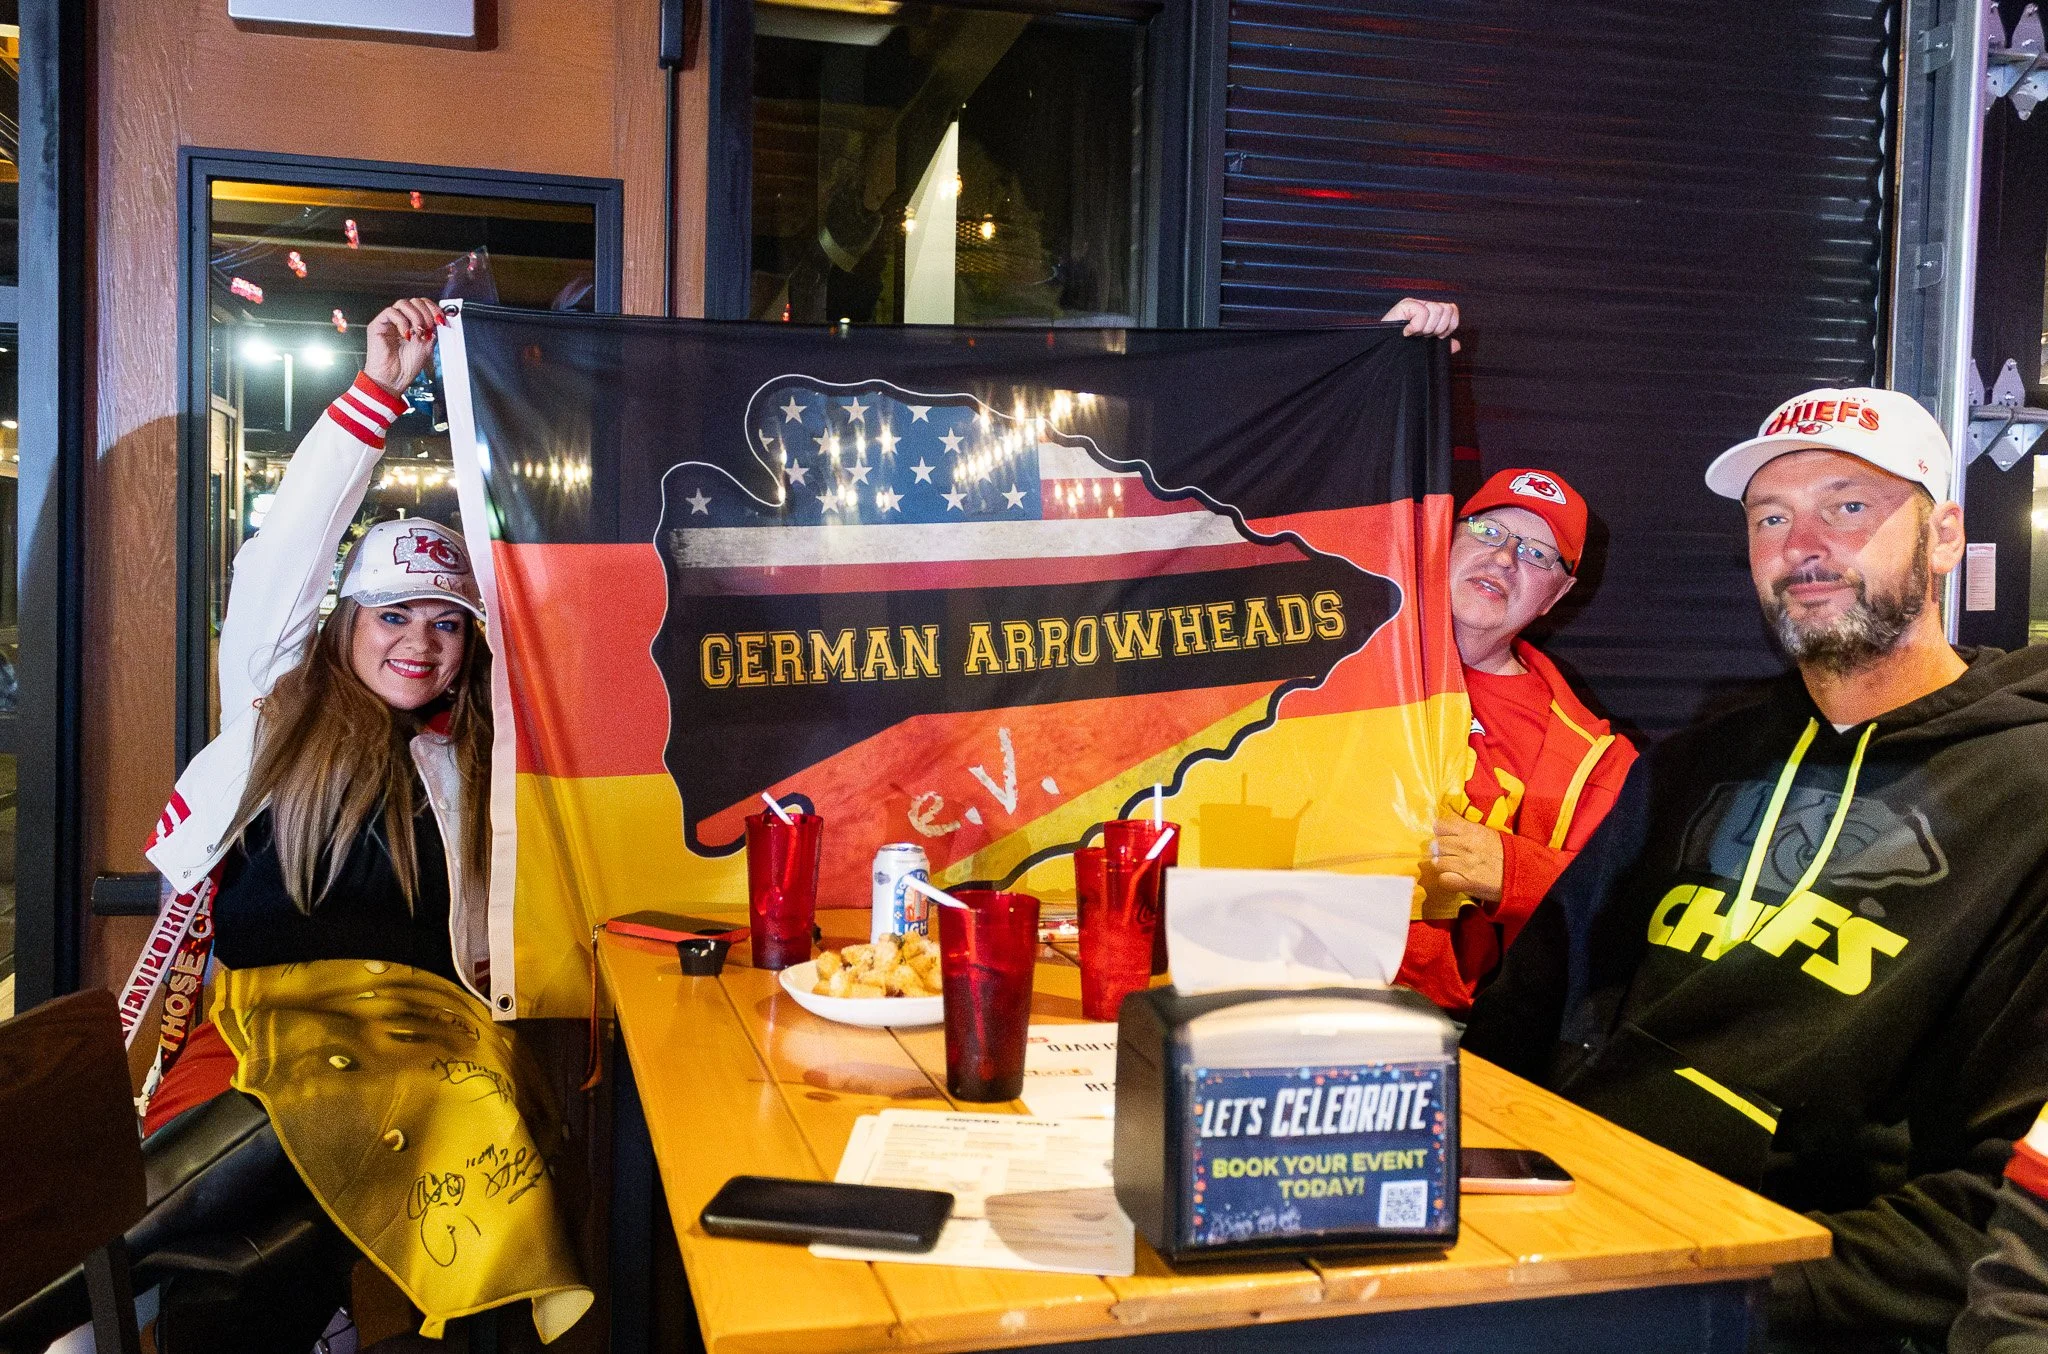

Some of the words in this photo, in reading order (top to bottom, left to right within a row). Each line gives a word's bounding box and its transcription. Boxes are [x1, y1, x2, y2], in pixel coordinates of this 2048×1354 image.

[415, 535, 461, 571] KC
[700, 626, 940, 689] GERMAN
[964, 589, 1347, 676] ARROWHEADS
[1647, 884, 1910, 996] CHFS
[159, 950, 206, 1052] THOSE
[1200, 1097, 1266, 1138] LET'S
[1270, 1081, 1434, 1138] CELEBRATE
[1211, 1156, 1280, 1179] BOOK
[1281, 1152, 1349, 1175] YOUR
[1351, 1149, 1428, 1172] EVENT
[1277, 1176, 1367, 1200] TODAY!
